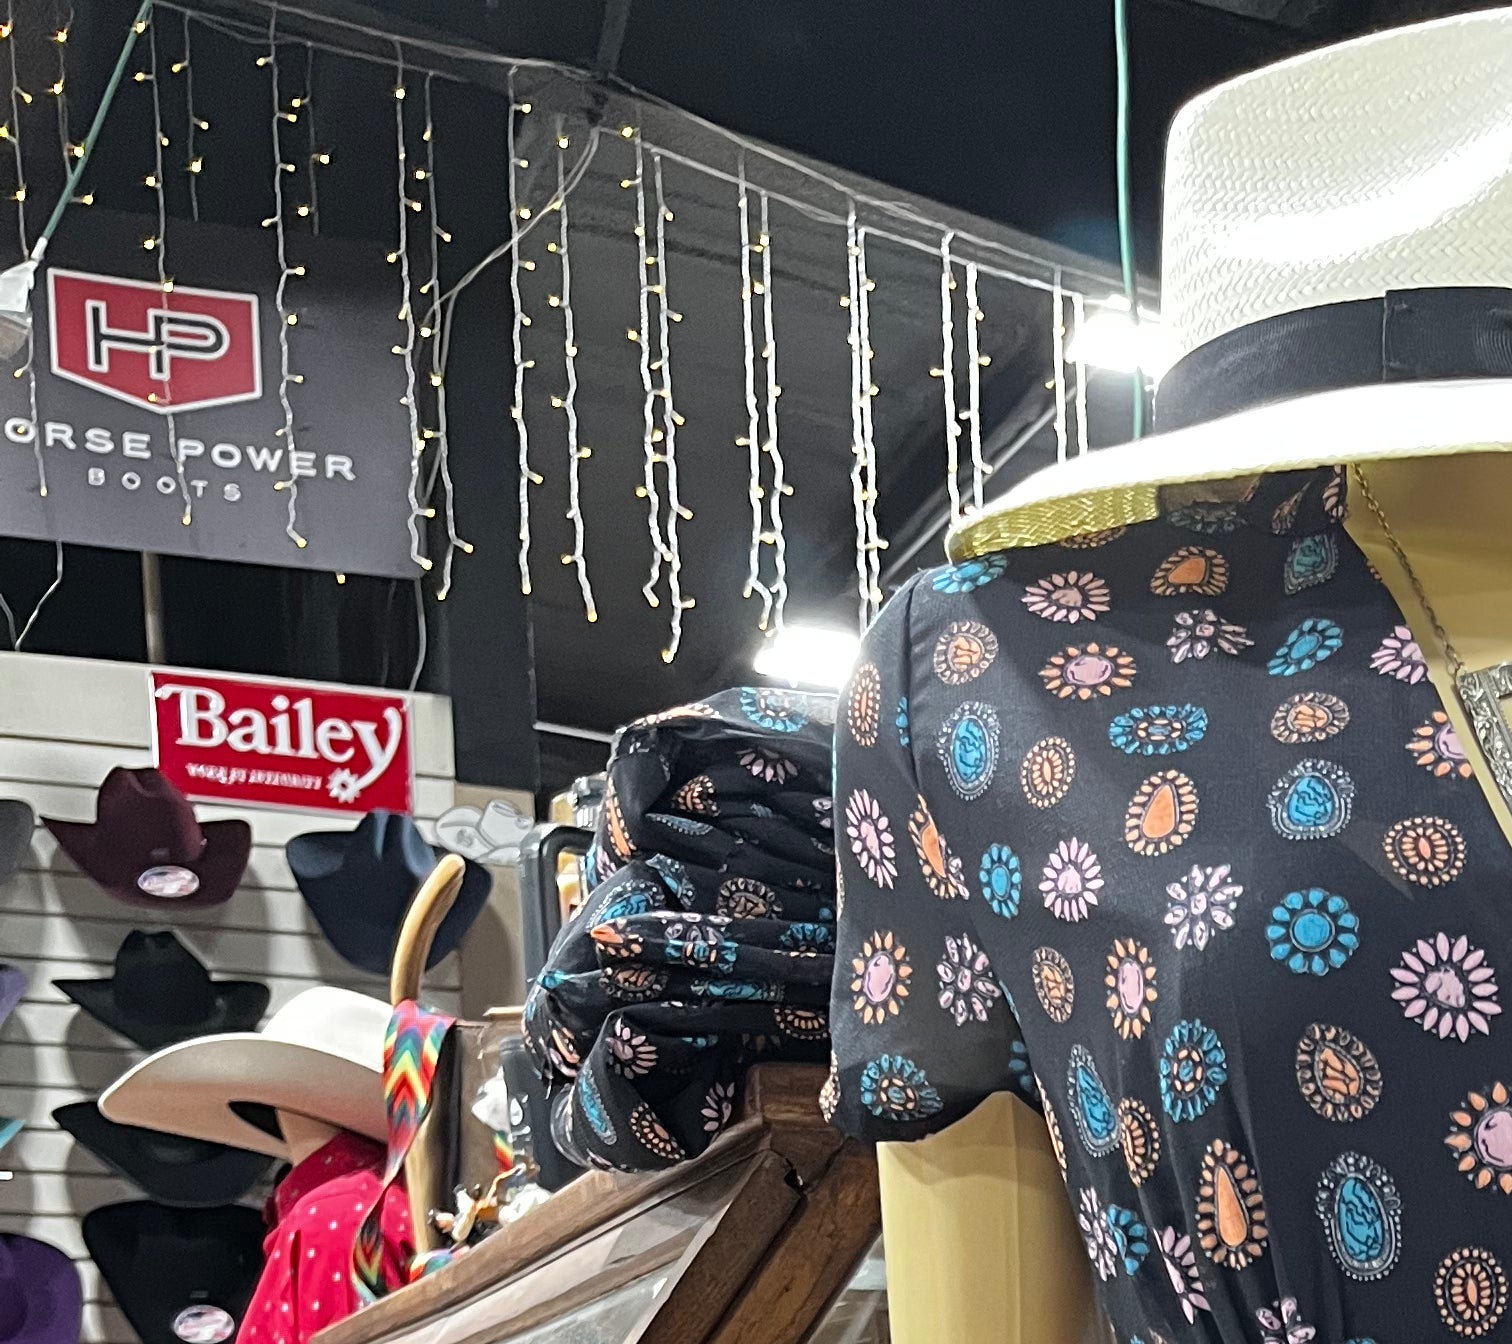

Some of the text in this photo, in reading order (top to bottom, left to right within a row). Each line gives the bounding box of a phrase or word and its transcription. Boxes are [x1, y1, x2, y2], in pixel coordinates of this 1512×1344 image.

[86, 299, 230, 380] HP
[4, 417, 356, 481] ORSE POWER
[87, 467, 242, 501] BOOTS
[155, 683, 402, 790] Bailey
